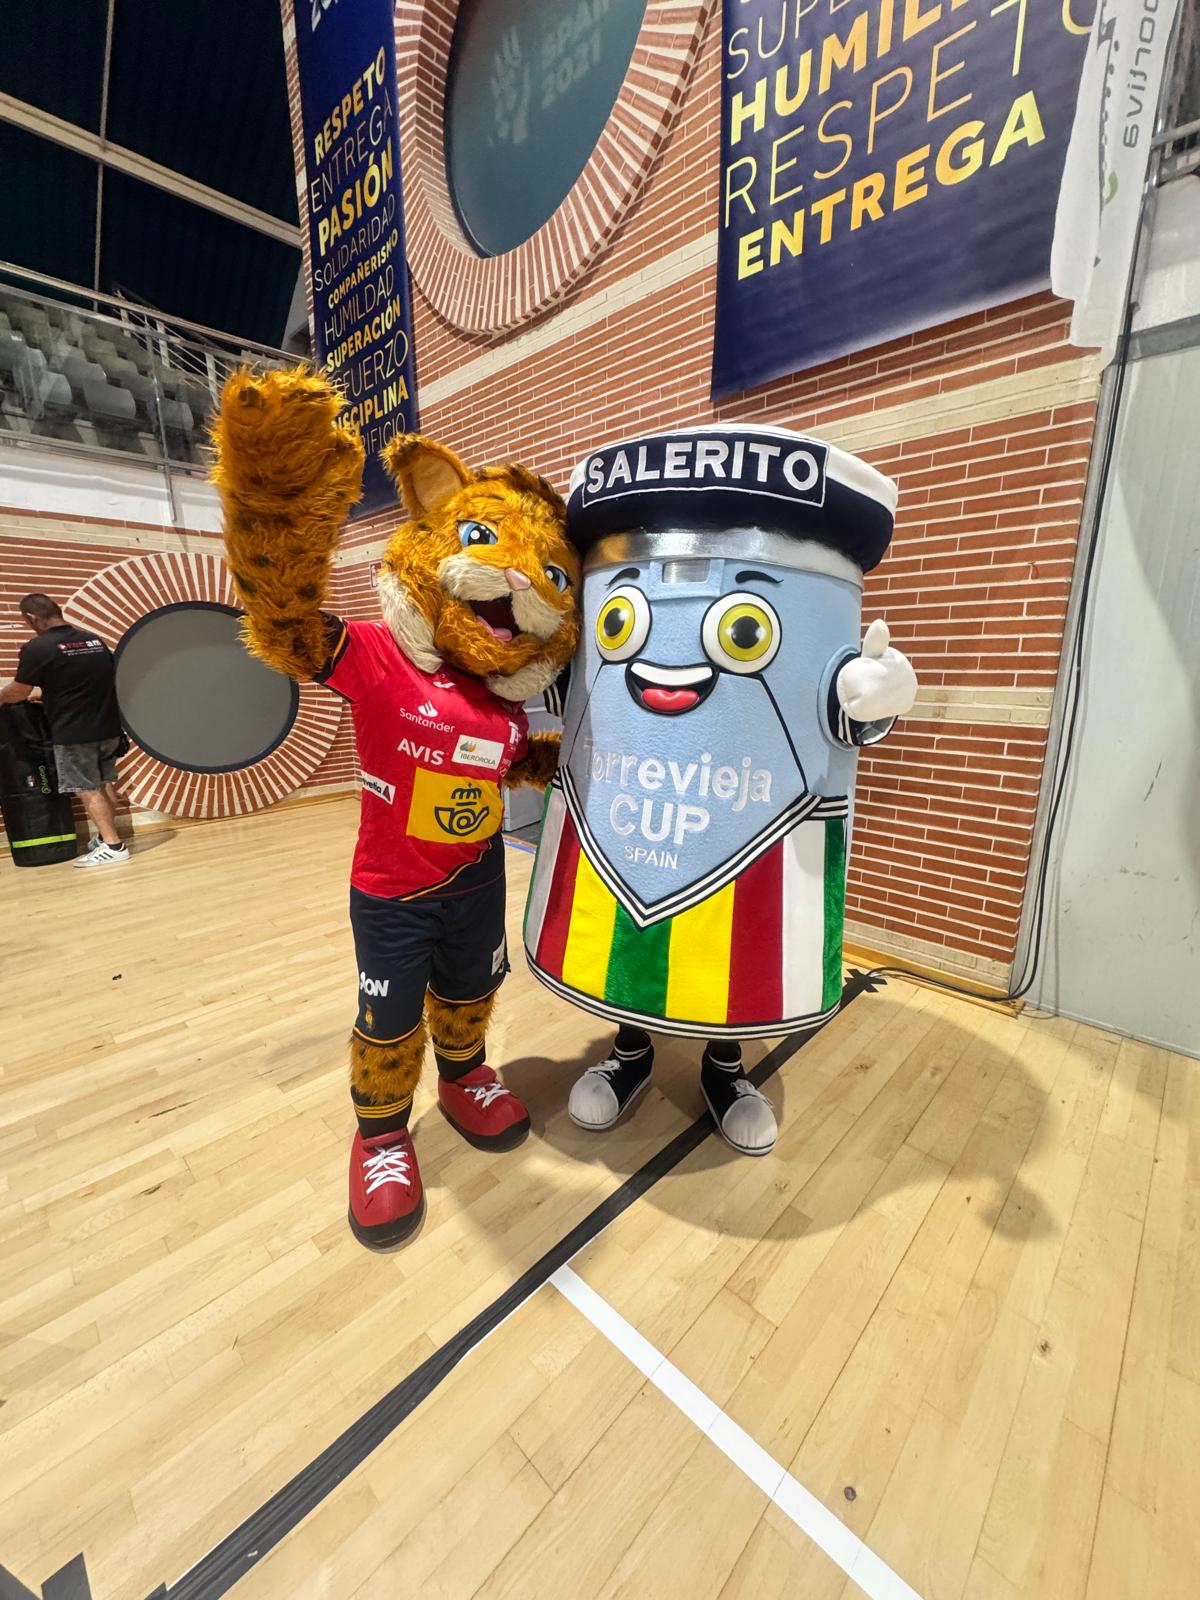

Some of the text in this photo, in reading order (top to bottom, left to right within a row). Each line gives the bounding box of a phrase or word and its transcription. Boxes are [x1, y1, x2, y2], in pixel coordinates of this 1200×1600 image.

[314, 45, 386, 167] RESPETO
[730, 0, 969, 146] HUMIL
[310, 87, 393, 214] ENTREGA
[737, 90, 1046, 281] ENTREGA
[318, 136, 394, 257] PASIÓN
[314, 193, 395, 292] SOLIDARIDAD
[328, 228, 399, 310] COMPAÑERISMO
[324, 264, 395, 346] HUMILDAD
[326, 294, 401, 373] SUPERACIÓN
[587, 440, 819, 494] SALERITO
[397, 738, 445, 766] AVIS
[399, 707, 456, 733] Santander
[460, 753, 496, 766] IBERDROLA
[609, 793, 711, 845] CUP
[623, 845, 679, 870] SPAIN
